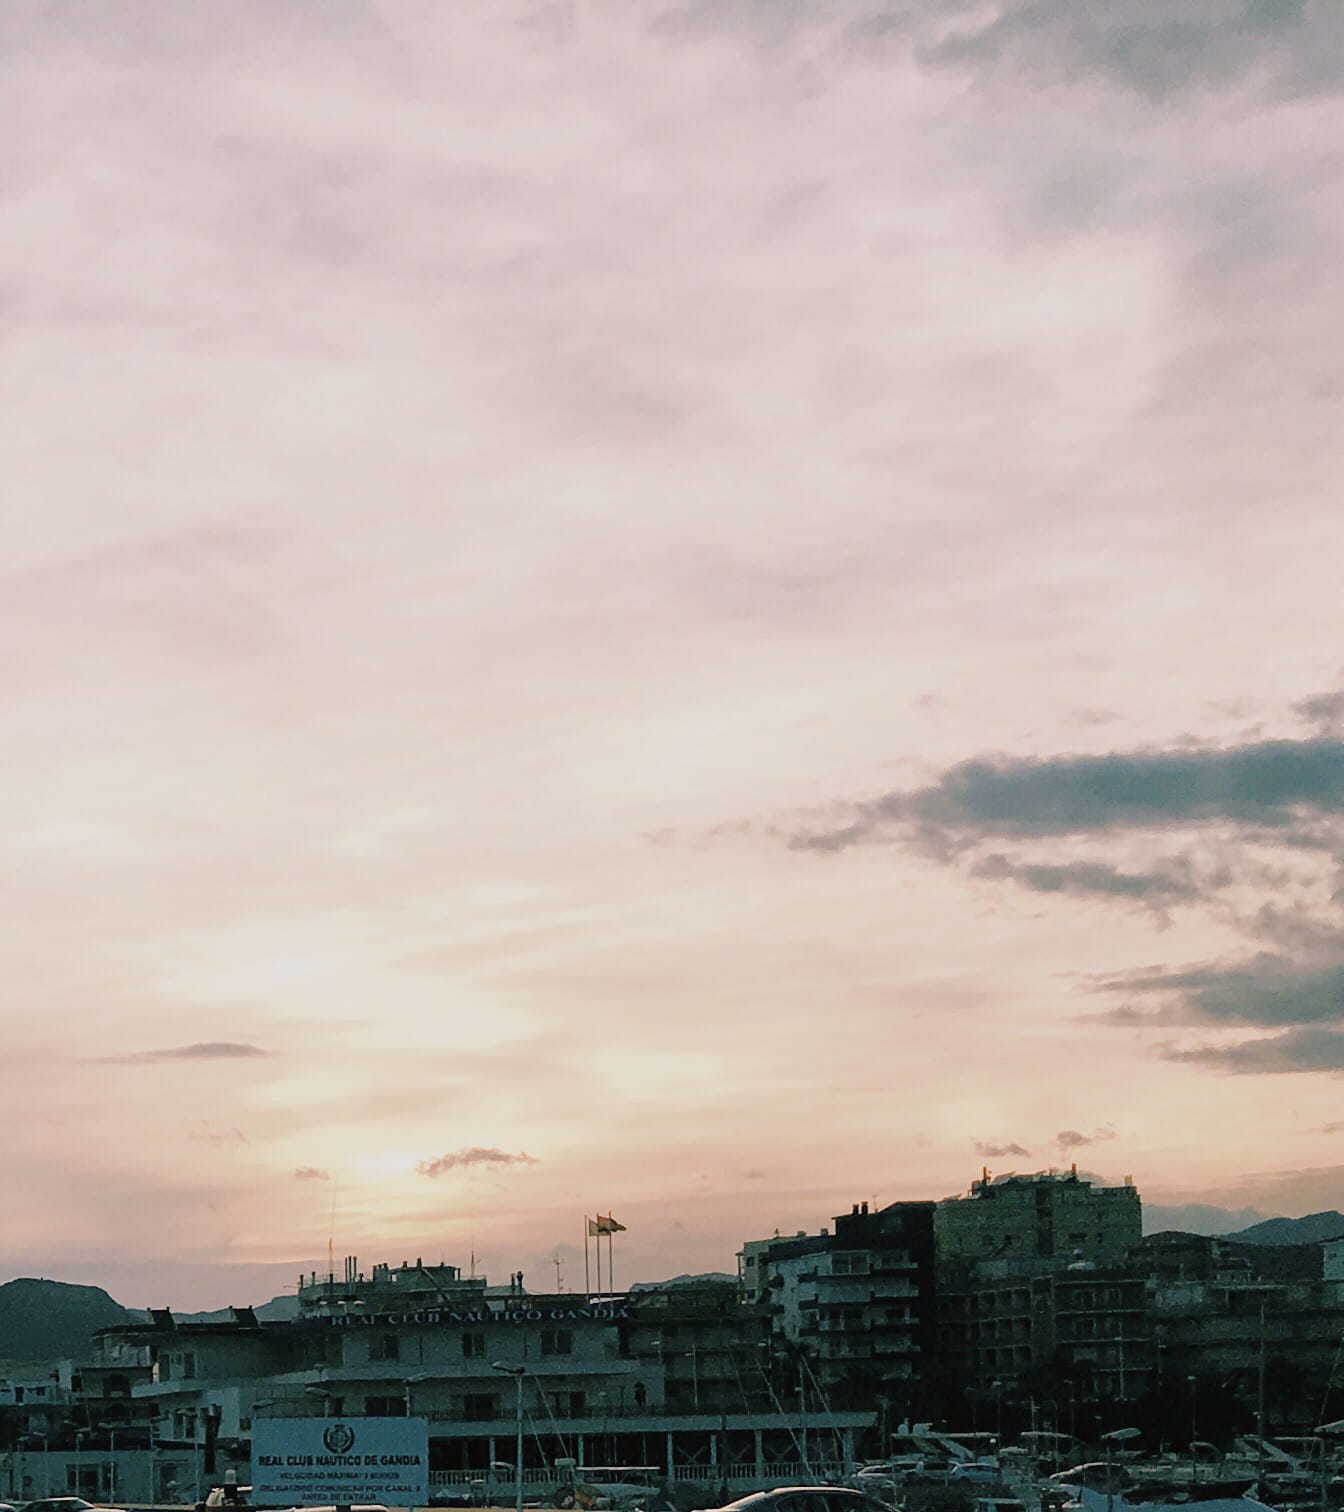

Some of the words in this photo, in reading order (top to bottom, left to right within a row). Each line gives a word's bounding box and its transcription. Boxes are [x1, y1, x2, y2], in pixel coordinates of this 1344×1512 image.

[387, 1312, 441, 1325] CLUB
[258, 1455, 284, 1466] REAL
[287, 1455, 313, 1466] CLUB
[364, 1455, 377, 1466] DE
